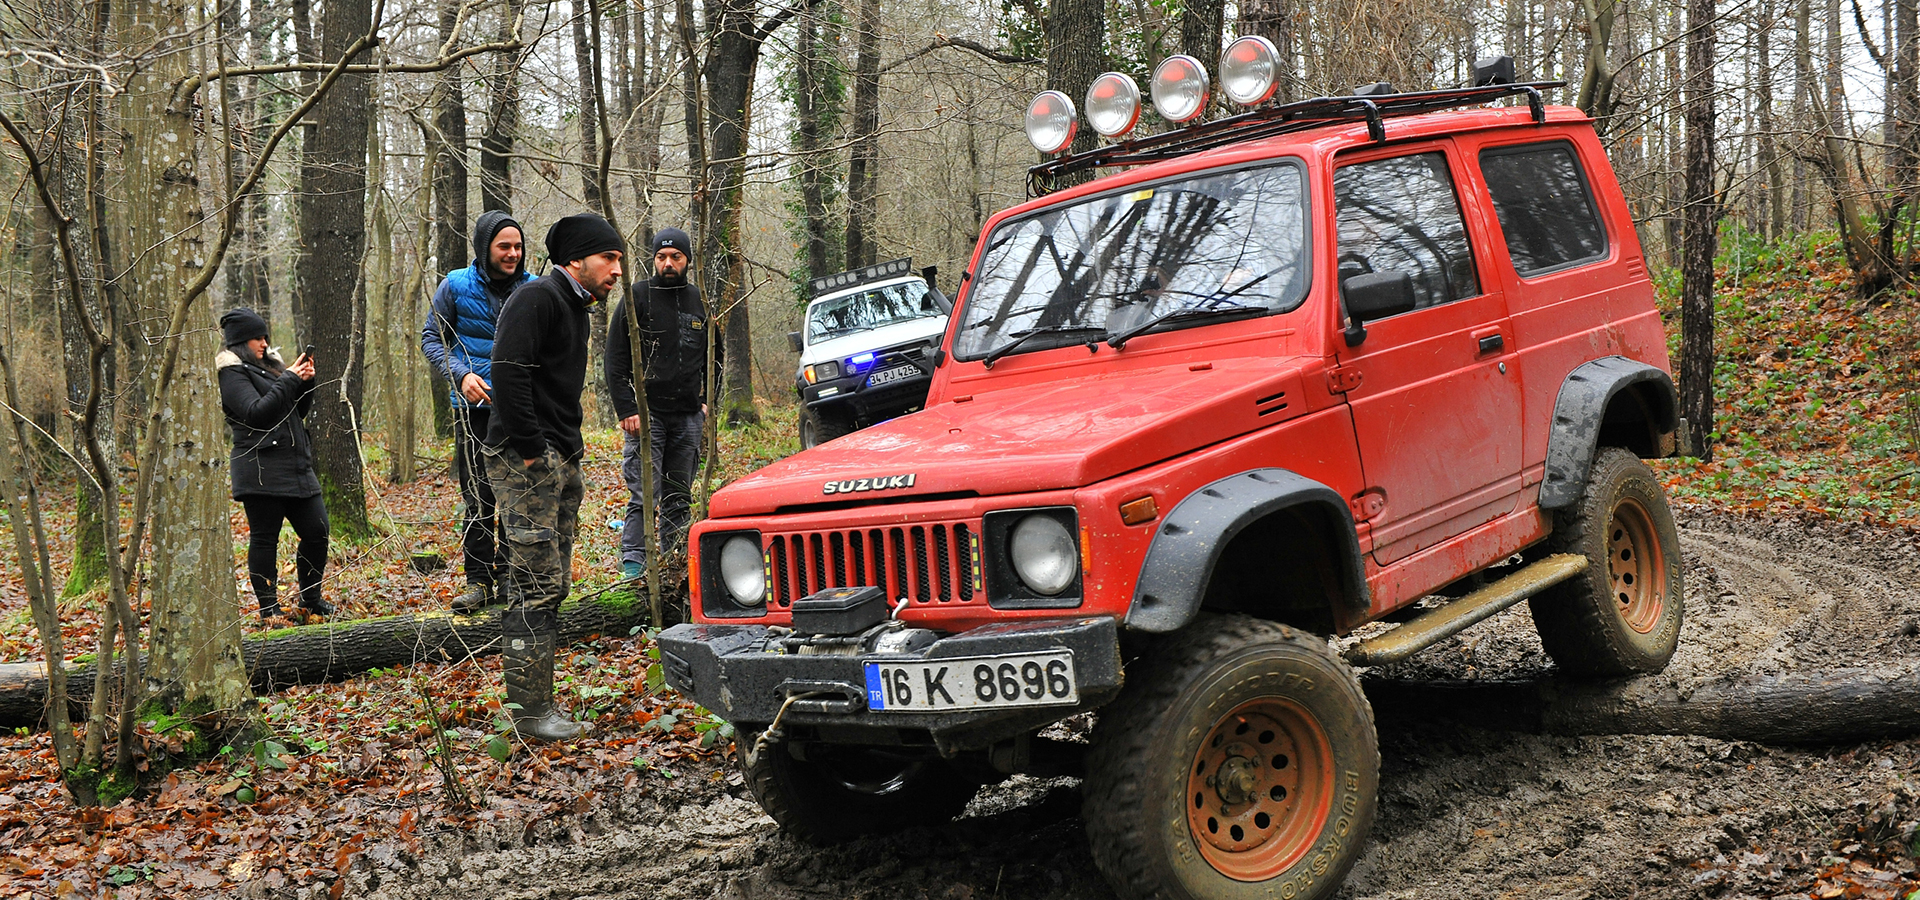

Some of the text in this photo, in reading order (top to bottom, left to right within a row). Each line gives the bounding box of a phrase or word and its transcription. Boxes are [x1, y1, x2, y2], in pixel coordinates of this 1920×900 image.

[870, 375, 881, 385] 34
[883, 371, 895, 381] PJ
[823, 473, 916, 494] SUZUKI
[881, 659, 1070, 706] 16 K 8696
[870, 690, 883, 701] TR
